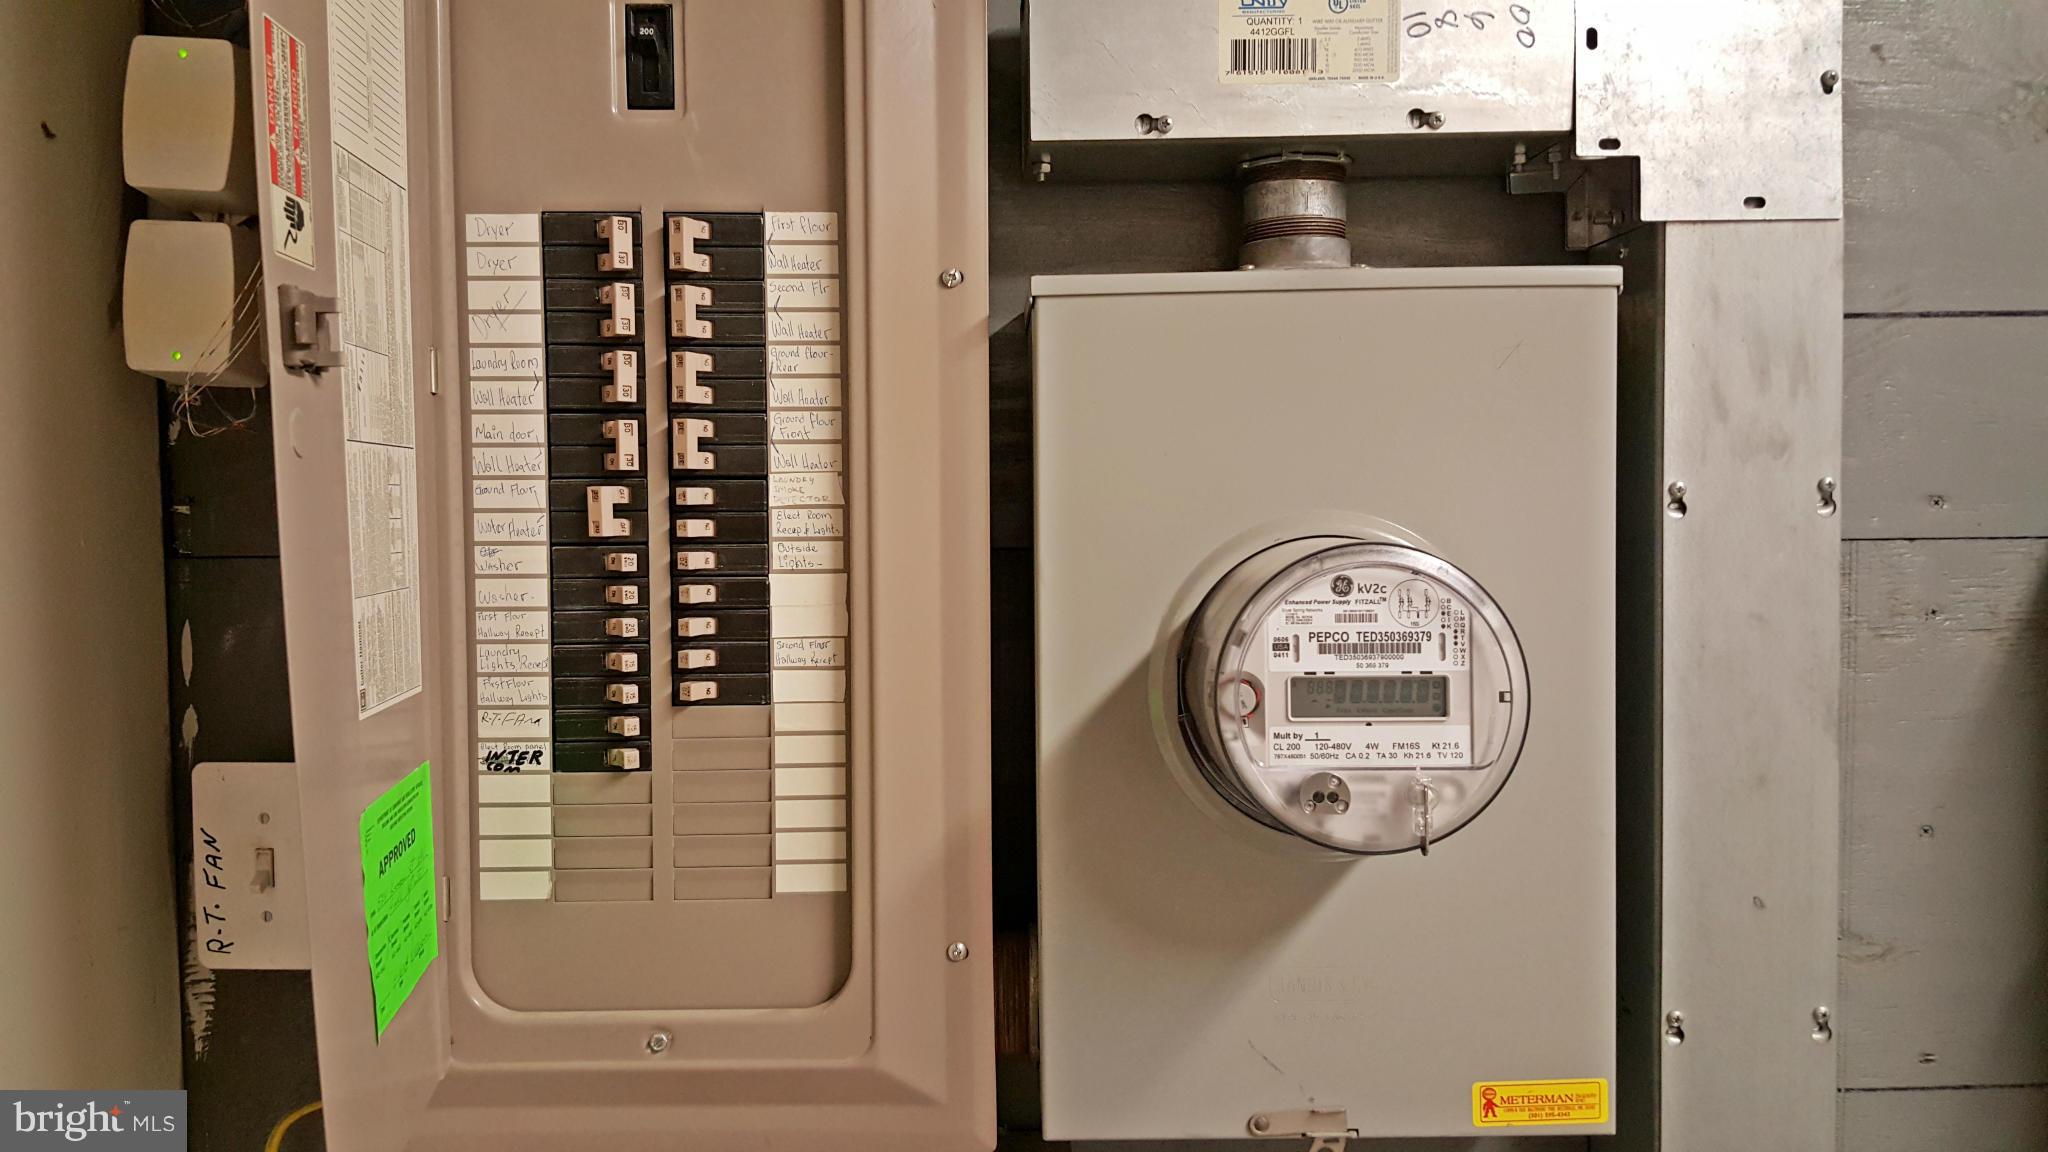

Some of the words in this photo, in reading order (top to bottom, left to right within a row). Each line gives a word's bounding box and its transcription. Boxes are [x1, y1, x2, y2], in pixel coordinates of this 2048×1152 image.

[640, 28, 654, 36] 200
[1250, 28, 1295, 36] 4412GGFL
[266, 53, 276, 126] DANGER
[474, 217, 515, 241] Dryer
[771, 216, 795, 231] First
[476, 251, 518, 275] Dryer
[768, 254, 790, 270] Wall
[790, 255, 823, 272] Heater
[769, 282, 804, 293] Second
[771, 320, 794, 337] Wall
[798, 325, 833, 340] Heater
[472, 350, 508, 371] Laundry
[511, 351, 539, 371] Room
[475, 425, 504, 440] Main
[780, 430, 811, 440] Front
[473, 452, 503, 475] Wall
[505, 455, 542, 474] Heater
[773, 451, 799, 469] Wall
[802, 452, 838, 470] Heater
[508, 518, 544, 539] Heater
[777, 542, 818, 554] Outside
[476, 557, 523, 572] Washer
[478, 611, 498, 621] First
[477, 627, 510, 641] Hallway
[1308, 631, 1350, 643] PEPCO
[1356, 631, 1433, 642] TED350369379
[479, 643, 520, 661] Laundry
[776, 640, 805, 651] Second
[775, 653, 807, 666] Hallway
[480, 691, 514, 706] Hallway
[1273, 732, 1291, 740] Mult
[1293, 732, 1303, 741] by
[1273, 743, 1284, 751] CL
[1286, 743, 1301, 751] 200
[1315, 743, 1353, 751] 120-480V
[1365, 742, 1379, 750] 4W
[1392, 742, 1421, 750] FM16S
[1431, 742, 1441, 750] Kt
[1442, 742, 1460, 750] 21.6
[485, 750, 544, 766] INTER
[1310, 752, 1340, 760] 50/60Hz
[486, 761, 521, 773] COM
[200, 827, 227, 890] FAN
[378, 828, 416, 879] APPROVED
[1500, 1093, 1574, 1105] METERMAN
